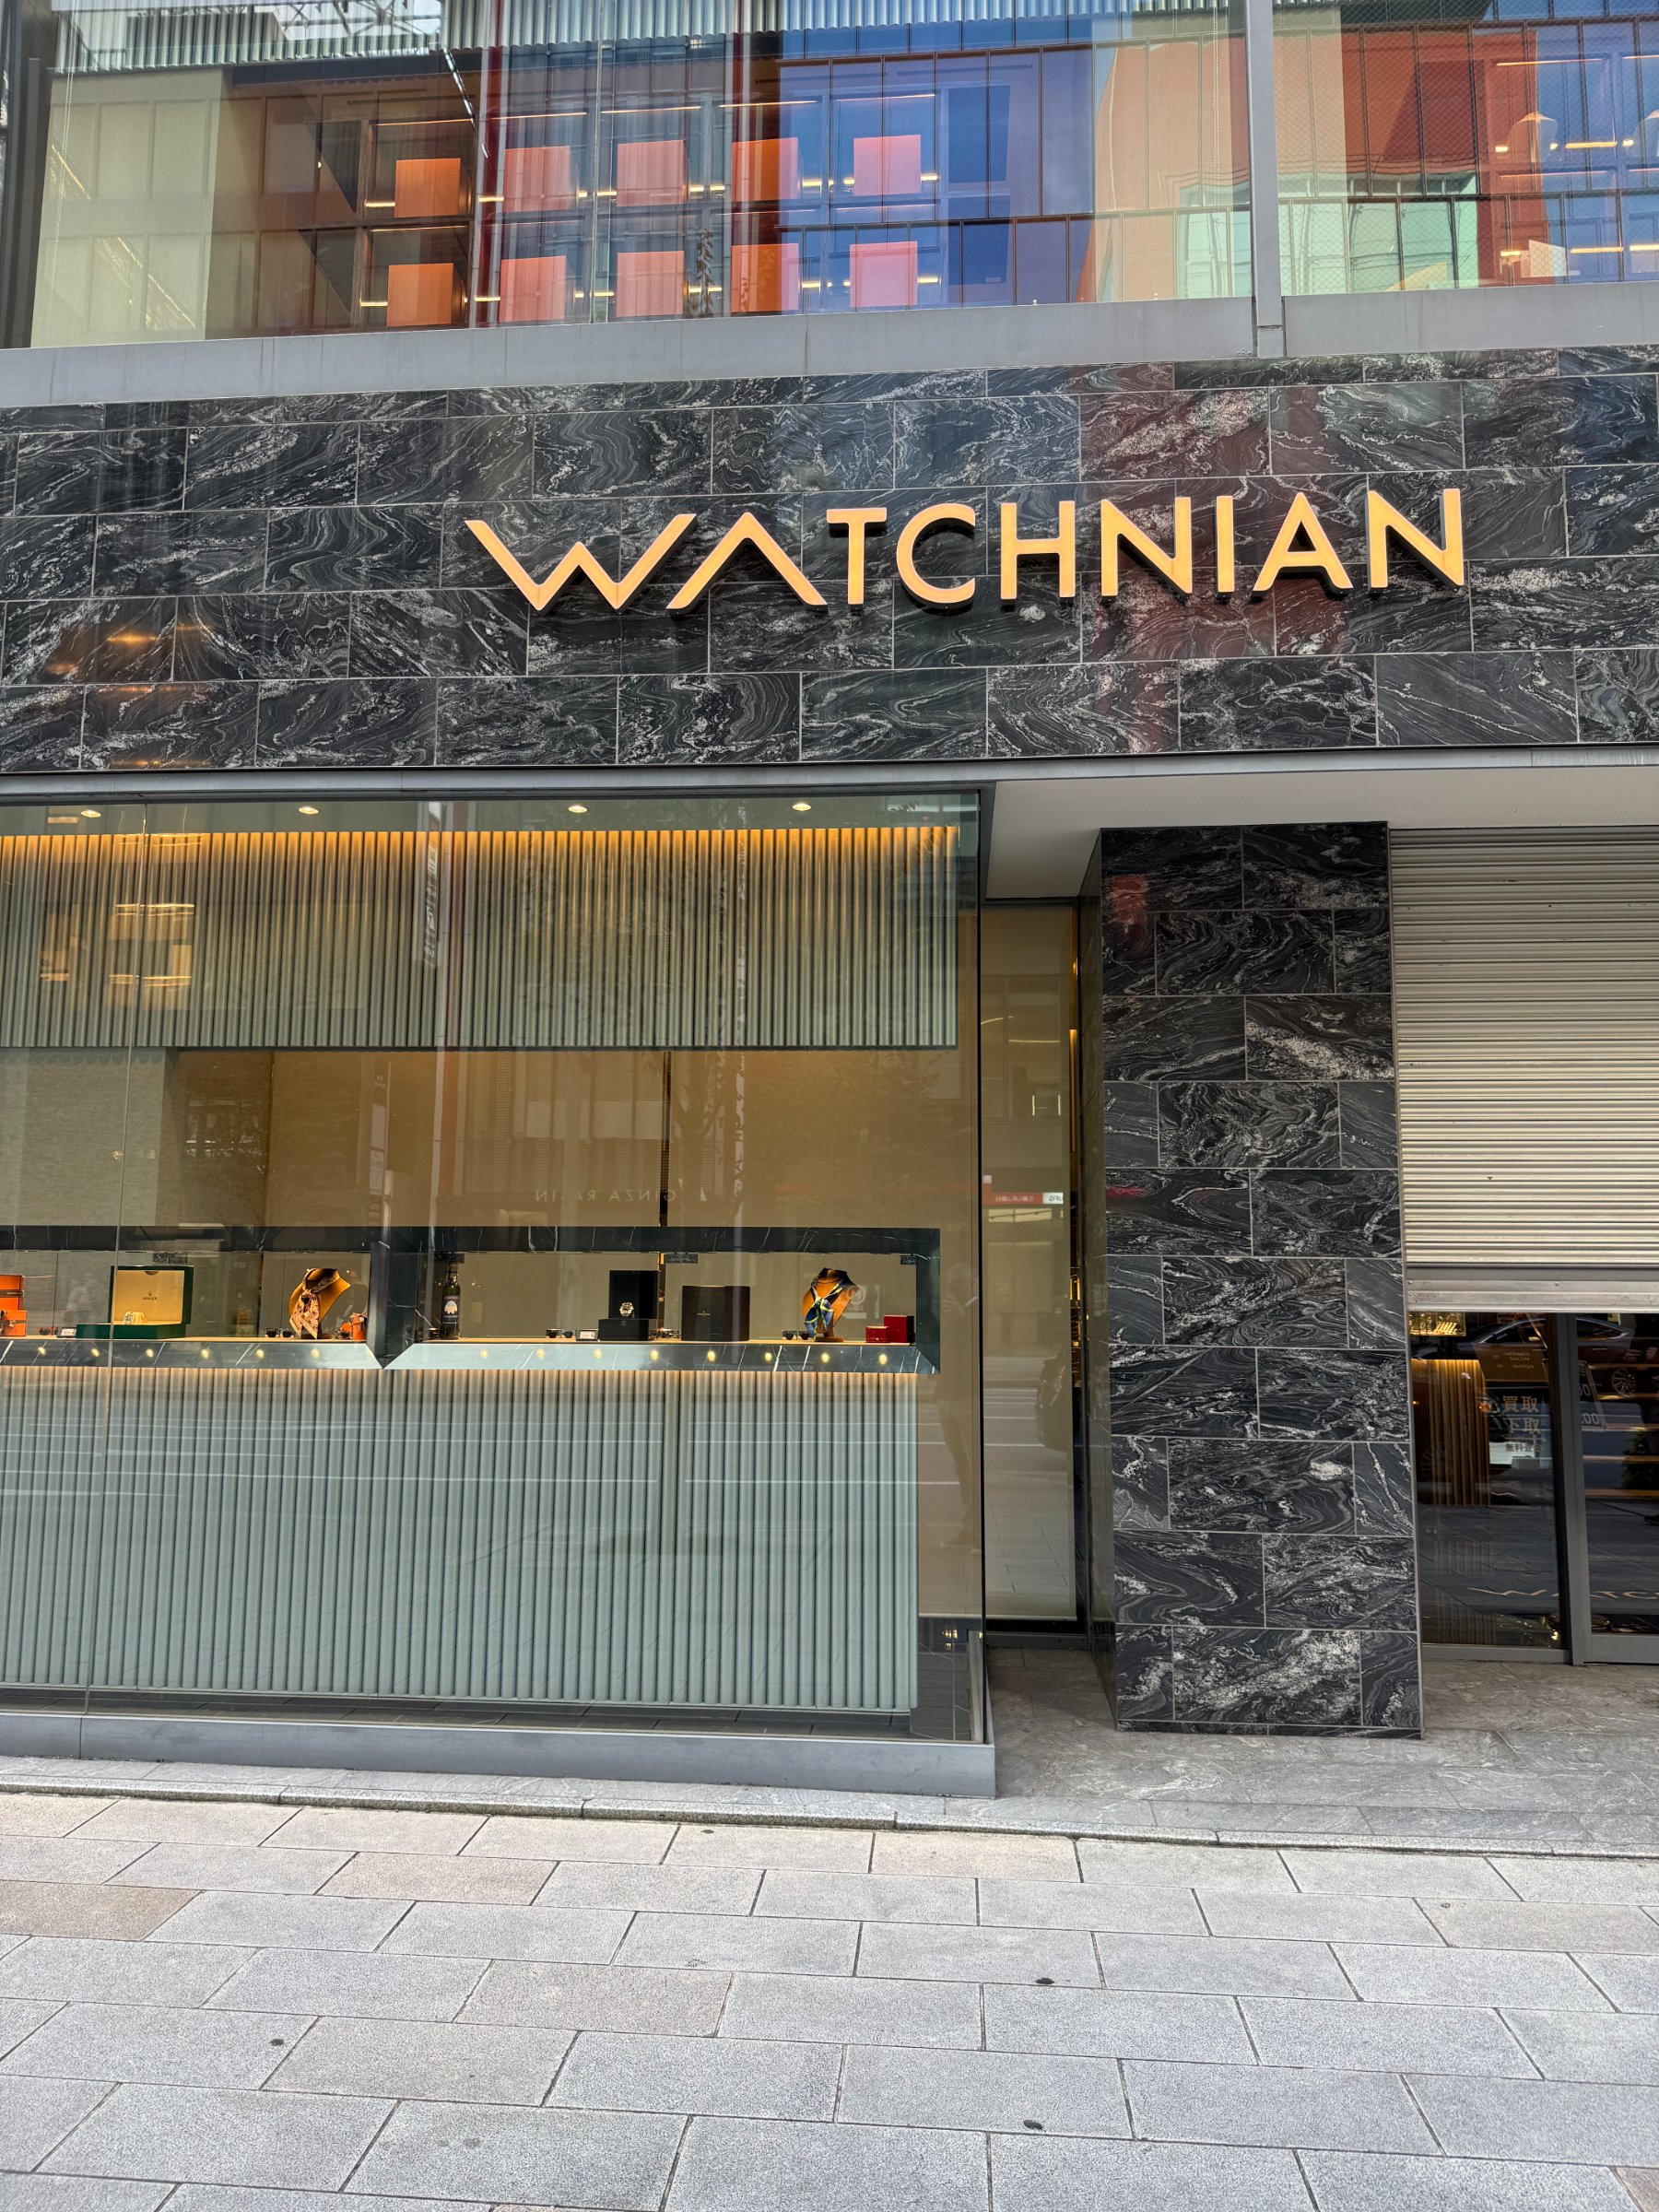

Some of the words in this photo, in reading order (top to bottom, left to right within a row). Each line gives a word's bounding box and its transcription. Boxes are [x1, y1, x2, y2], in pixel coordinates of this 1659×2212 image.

[465, 488, 1465, 612] WATCHNIAN
[1502, 1395, 1539, 1413] 買取
[1502, 1417, 1540, 1434] 下取
